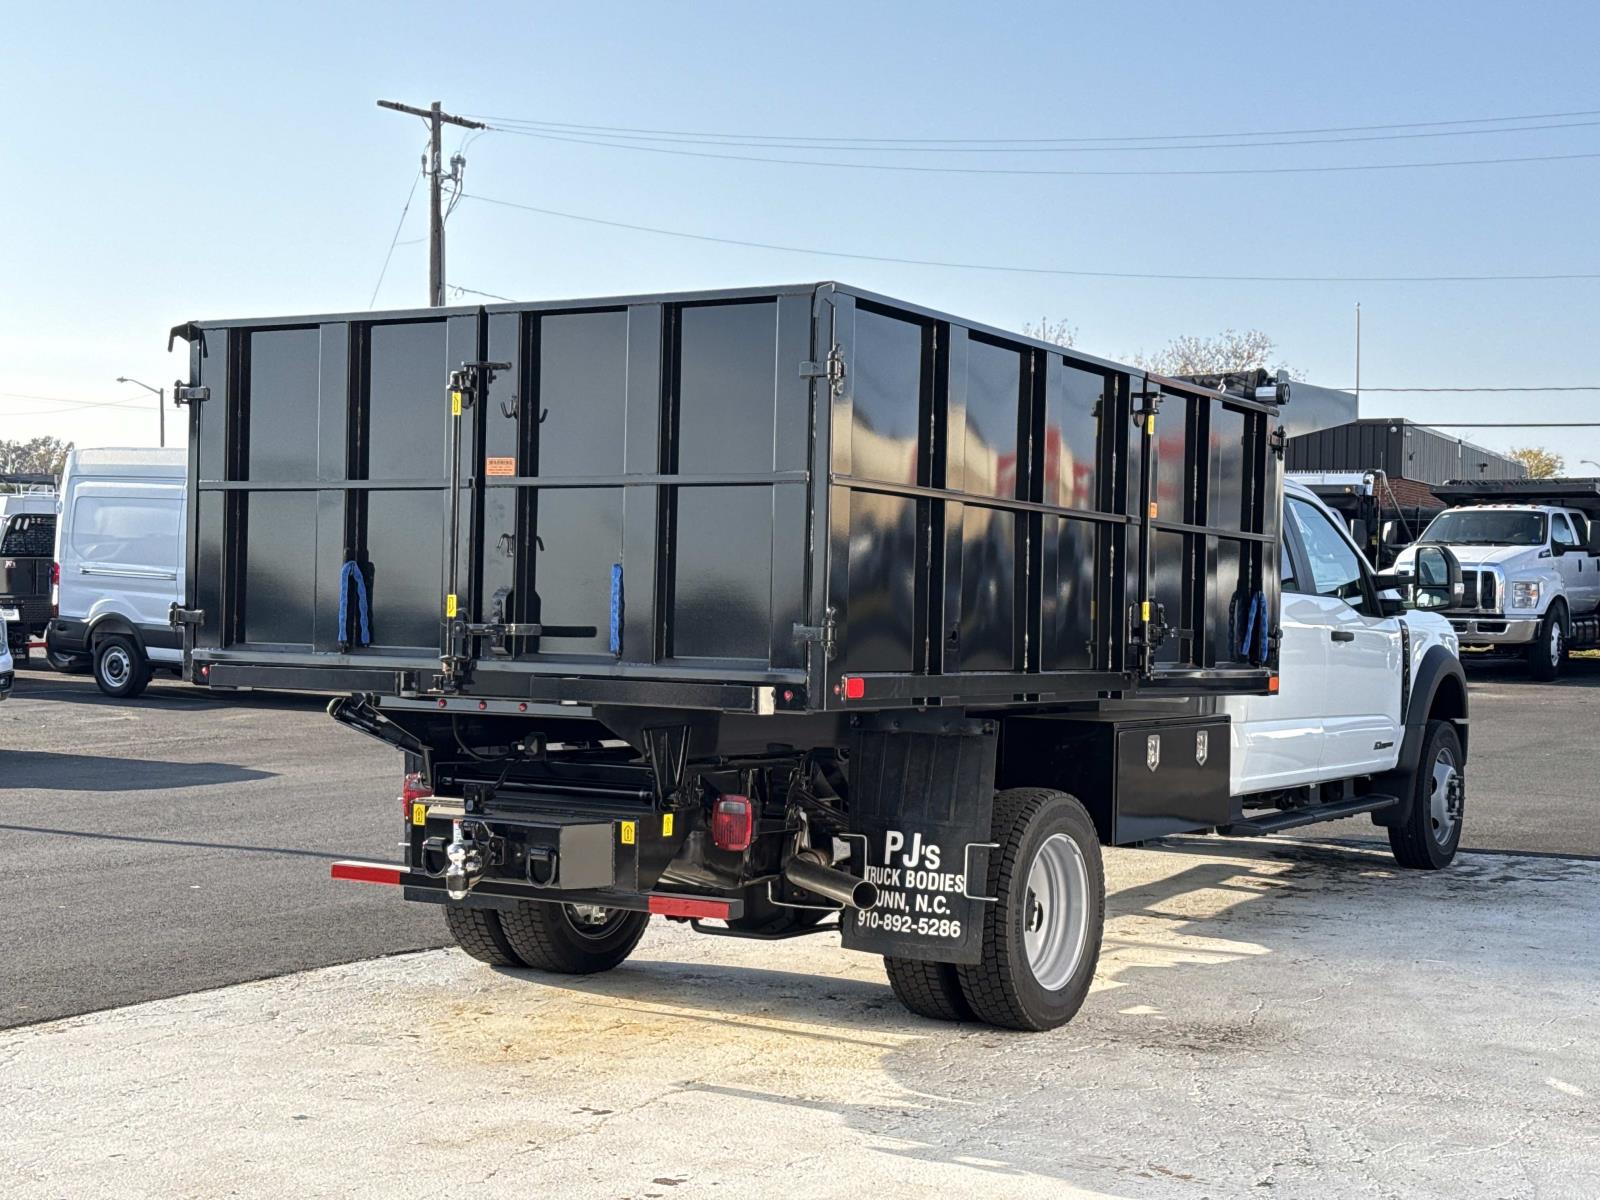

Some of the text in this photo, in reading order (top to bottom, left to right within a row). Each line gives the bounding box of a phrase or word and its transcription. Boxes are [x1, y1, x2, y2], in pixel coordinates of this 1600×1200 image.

[884, 830, 941, 870] PJ's
[905, 869, 965, 893] BODIES
[875, 889, 951, 915] UNN, N.C.
[858, 911, 961, 937] 910-892-5286
